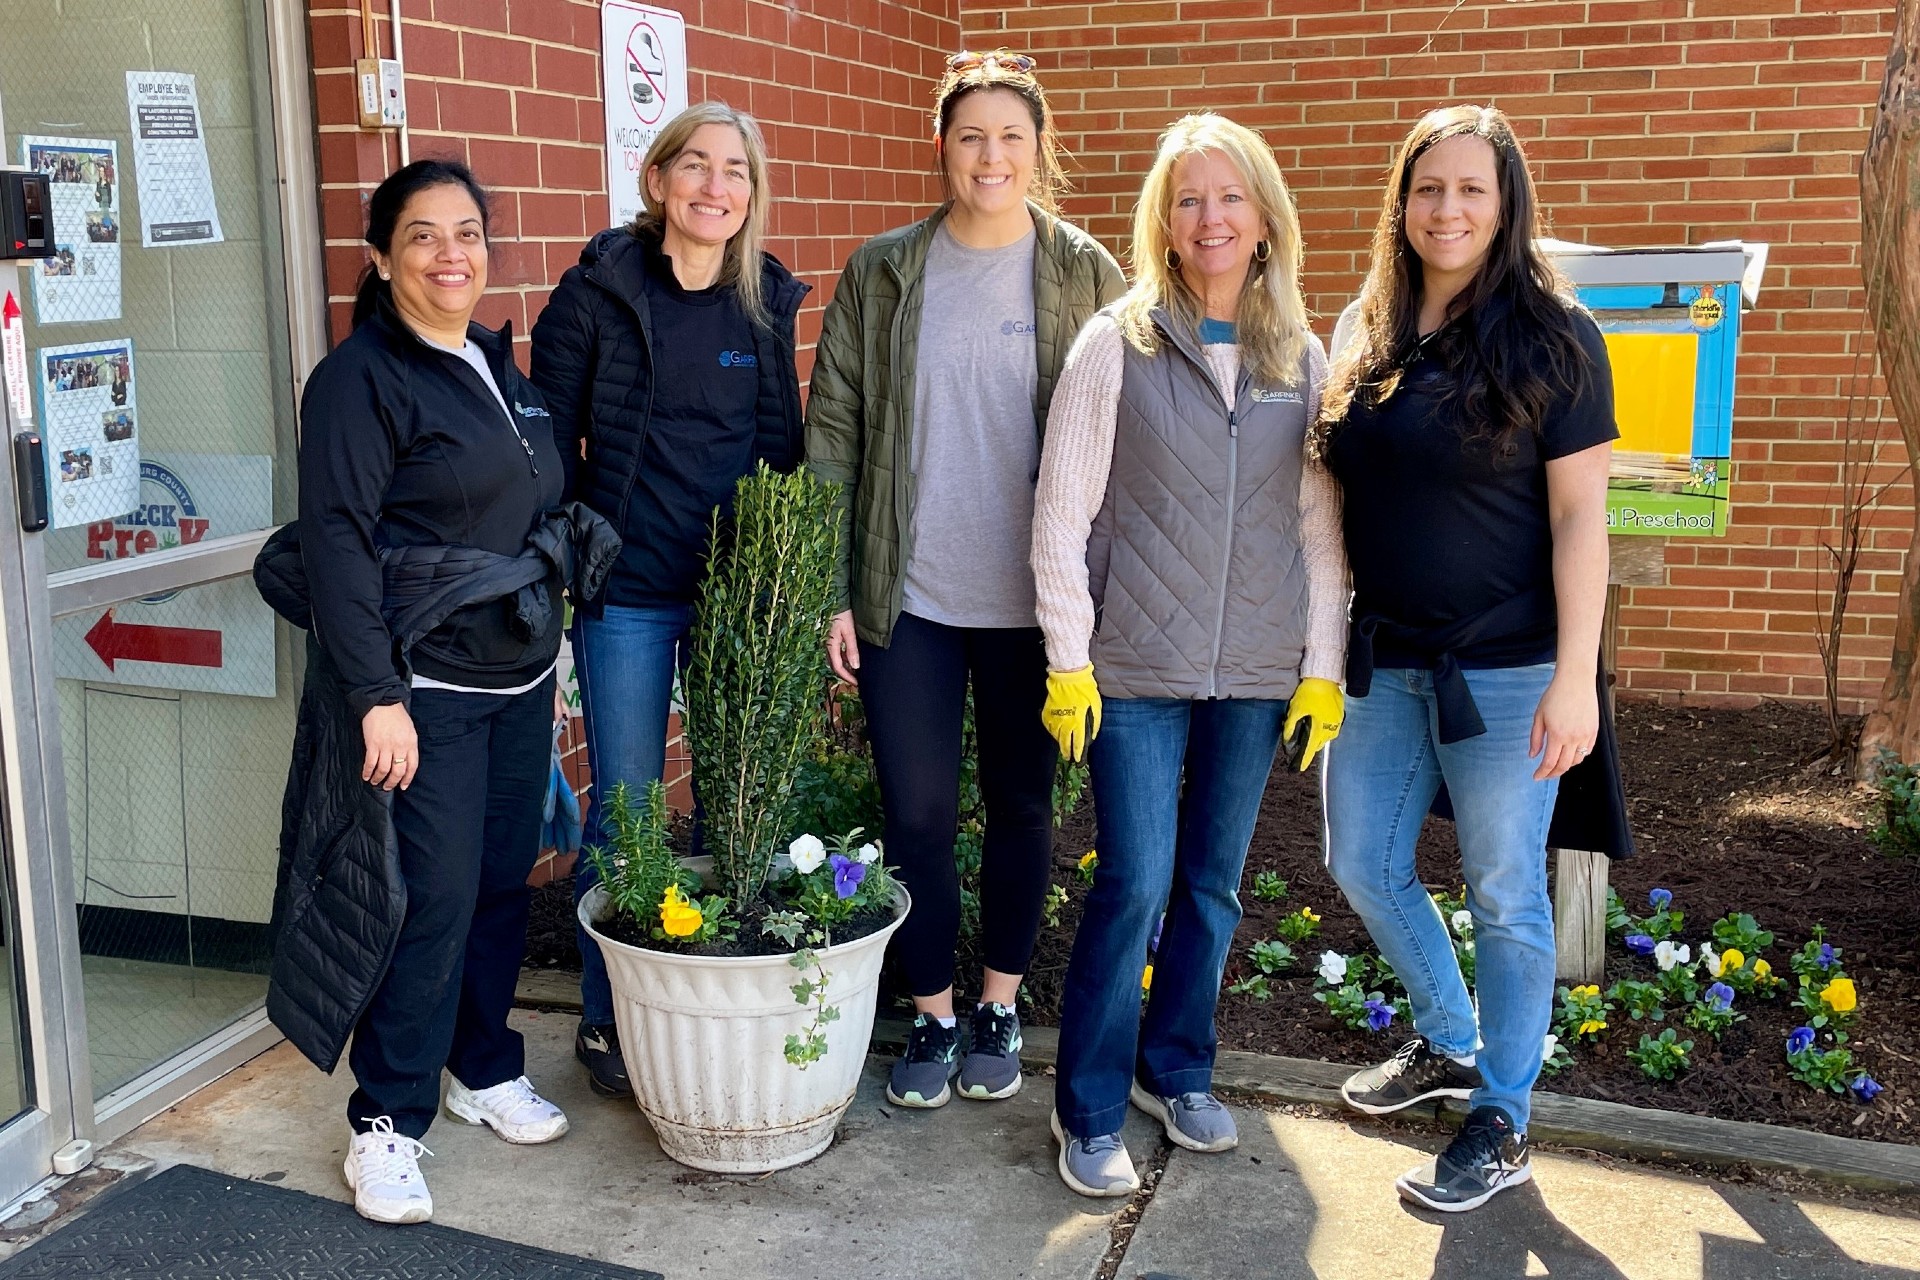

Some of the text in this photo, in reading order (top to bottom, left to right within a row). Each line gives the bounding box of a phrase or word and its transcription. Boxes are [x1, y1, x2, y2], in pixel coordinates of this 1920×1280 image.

[139, 83, 173, 94] EMPLOYEE
[615, 127, 650, 149] WELCOME
[159, 472, 191, 507] COUNTY
[1622, 507, 1715, 529] Preschool
[87, 521, 158, 559] Pre
